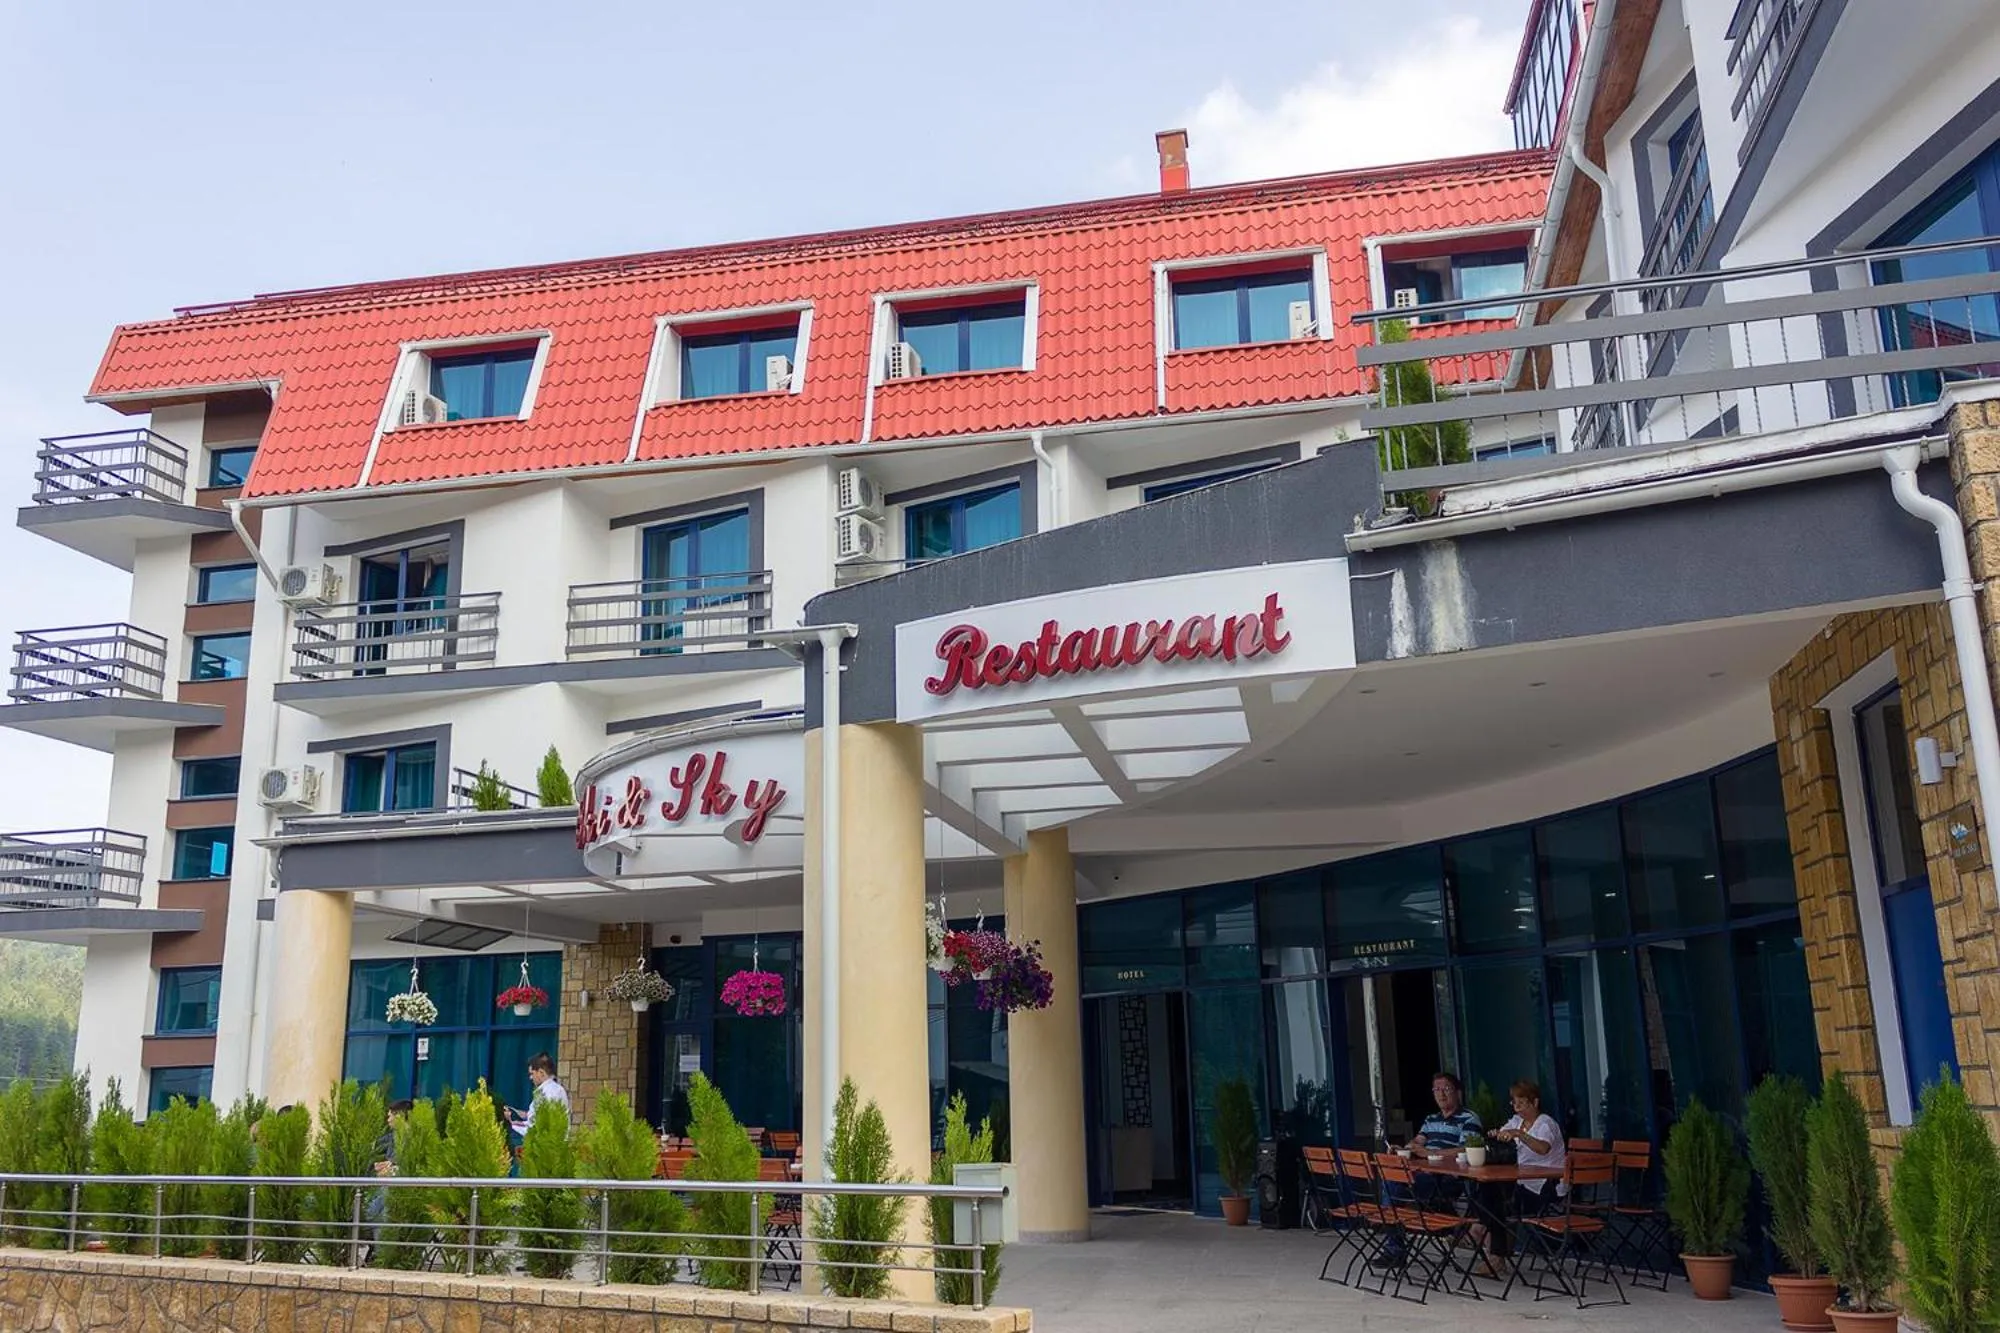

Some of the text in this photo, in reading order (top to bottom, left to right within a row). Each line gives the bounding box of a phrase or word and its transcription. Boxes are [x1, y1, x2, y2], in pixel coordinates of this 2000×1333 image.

[923, 591, 1293, 697] Restaurant
[615, 775, 651, 830] &
[661, 751, 788, 842] Sky
[1353, 939, 1415, 956] RESTAURANT
